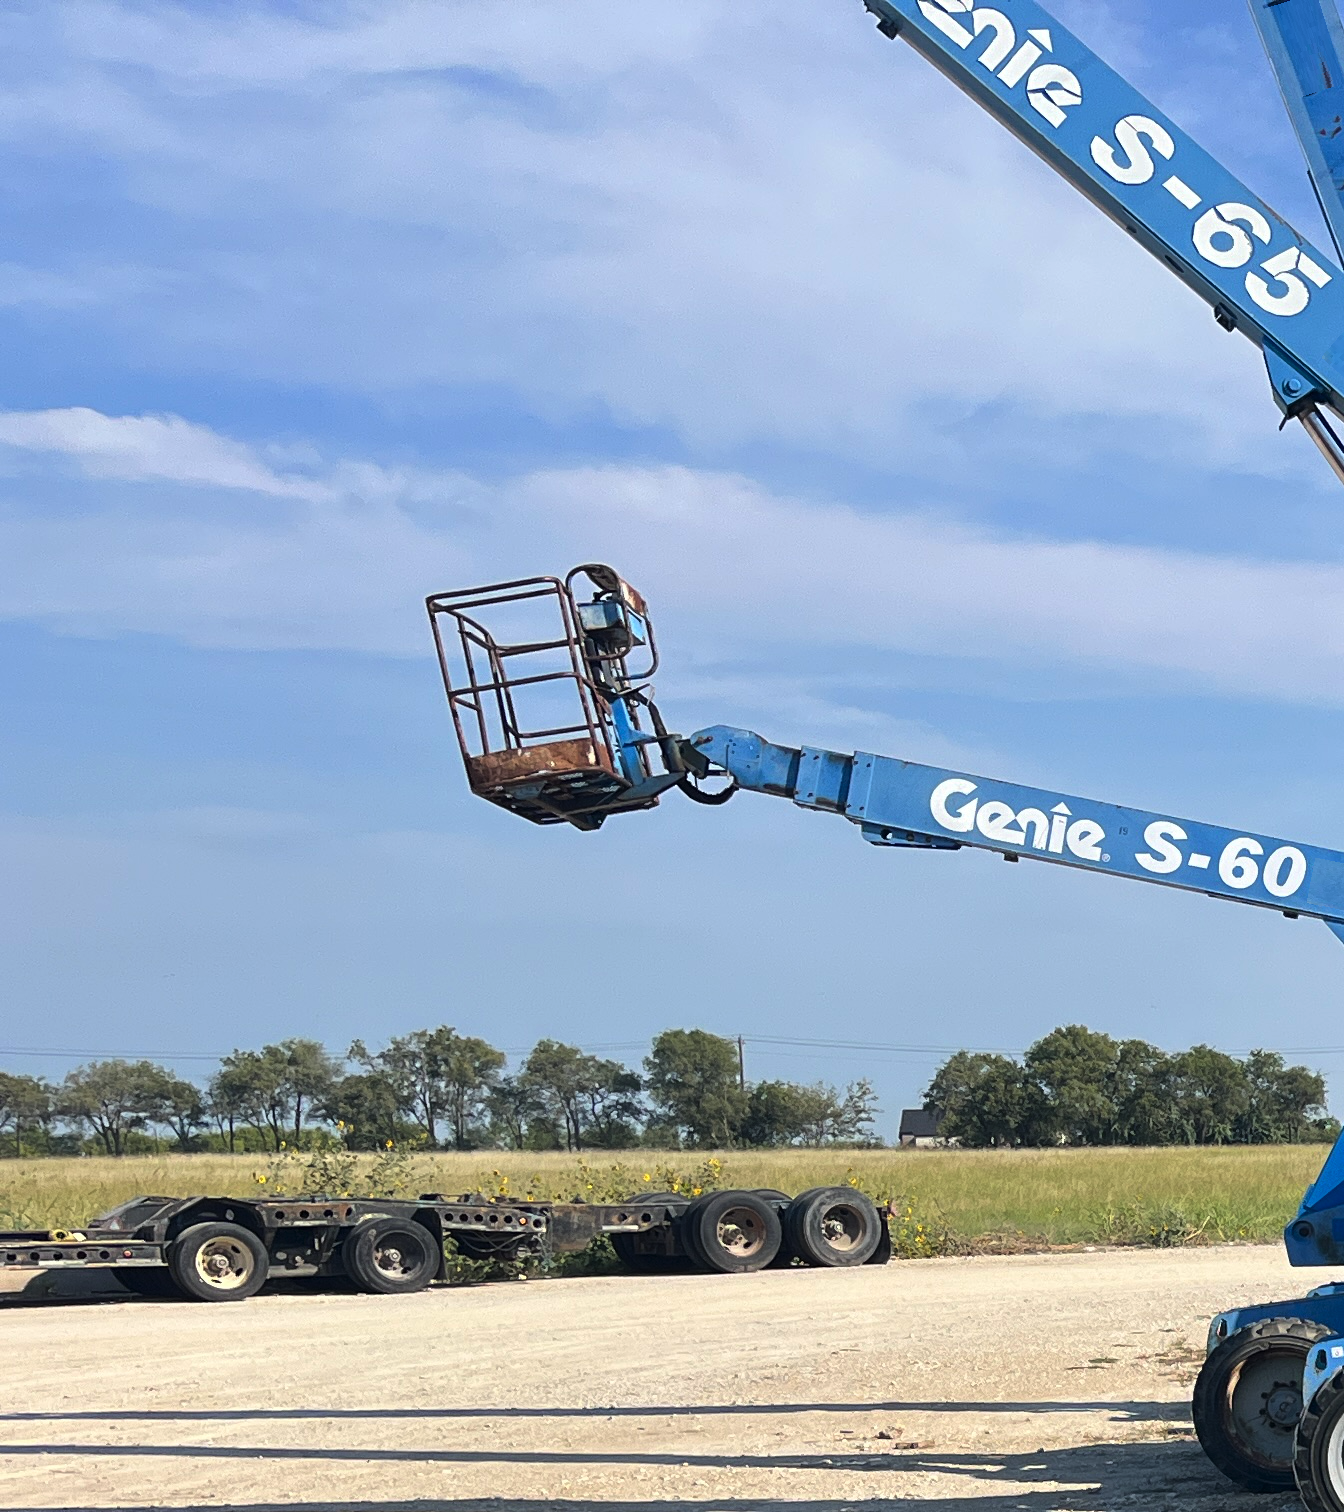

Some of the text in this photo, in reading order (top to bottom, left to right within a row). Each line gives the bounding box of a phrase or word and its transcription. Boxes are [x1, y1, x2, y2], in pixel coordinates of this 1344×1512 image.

[917, 0, 1333, 317] enie S-65
[930, 777, 1307, 898] Genie S-60
